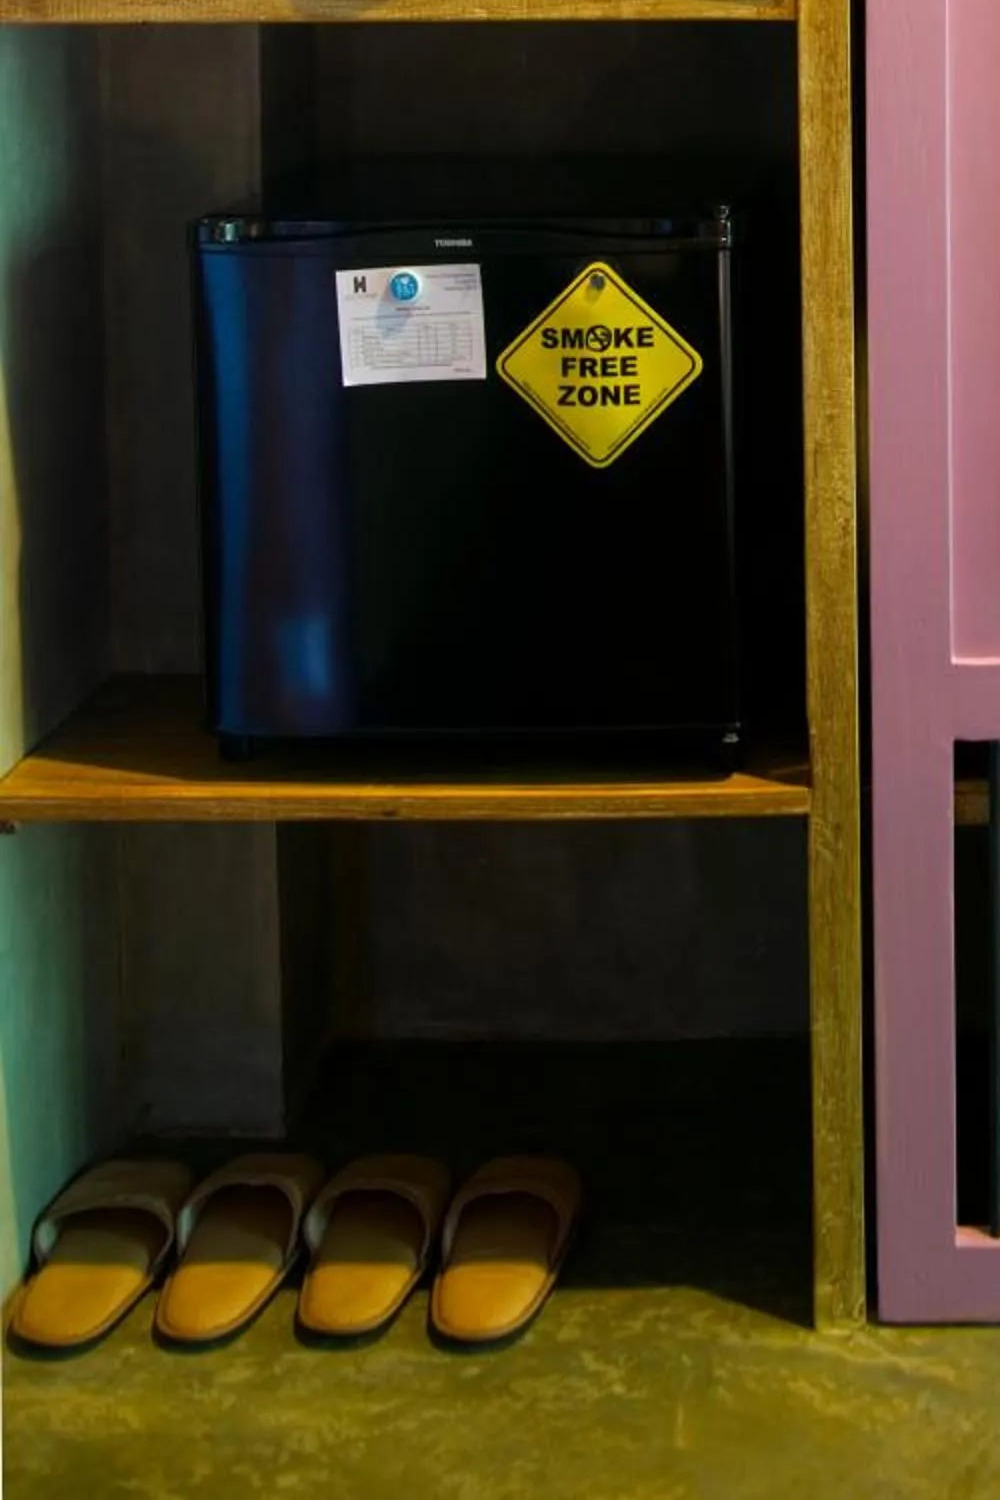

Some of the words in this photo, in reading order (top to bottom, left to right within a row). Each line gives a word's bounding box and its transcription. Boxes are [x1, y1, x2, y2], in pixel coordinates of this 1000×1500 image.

[541, 324, 655, 352] SMOKE
[561, 356, 638, 377] FREE
[557, 384, 641, 406] ZONE
